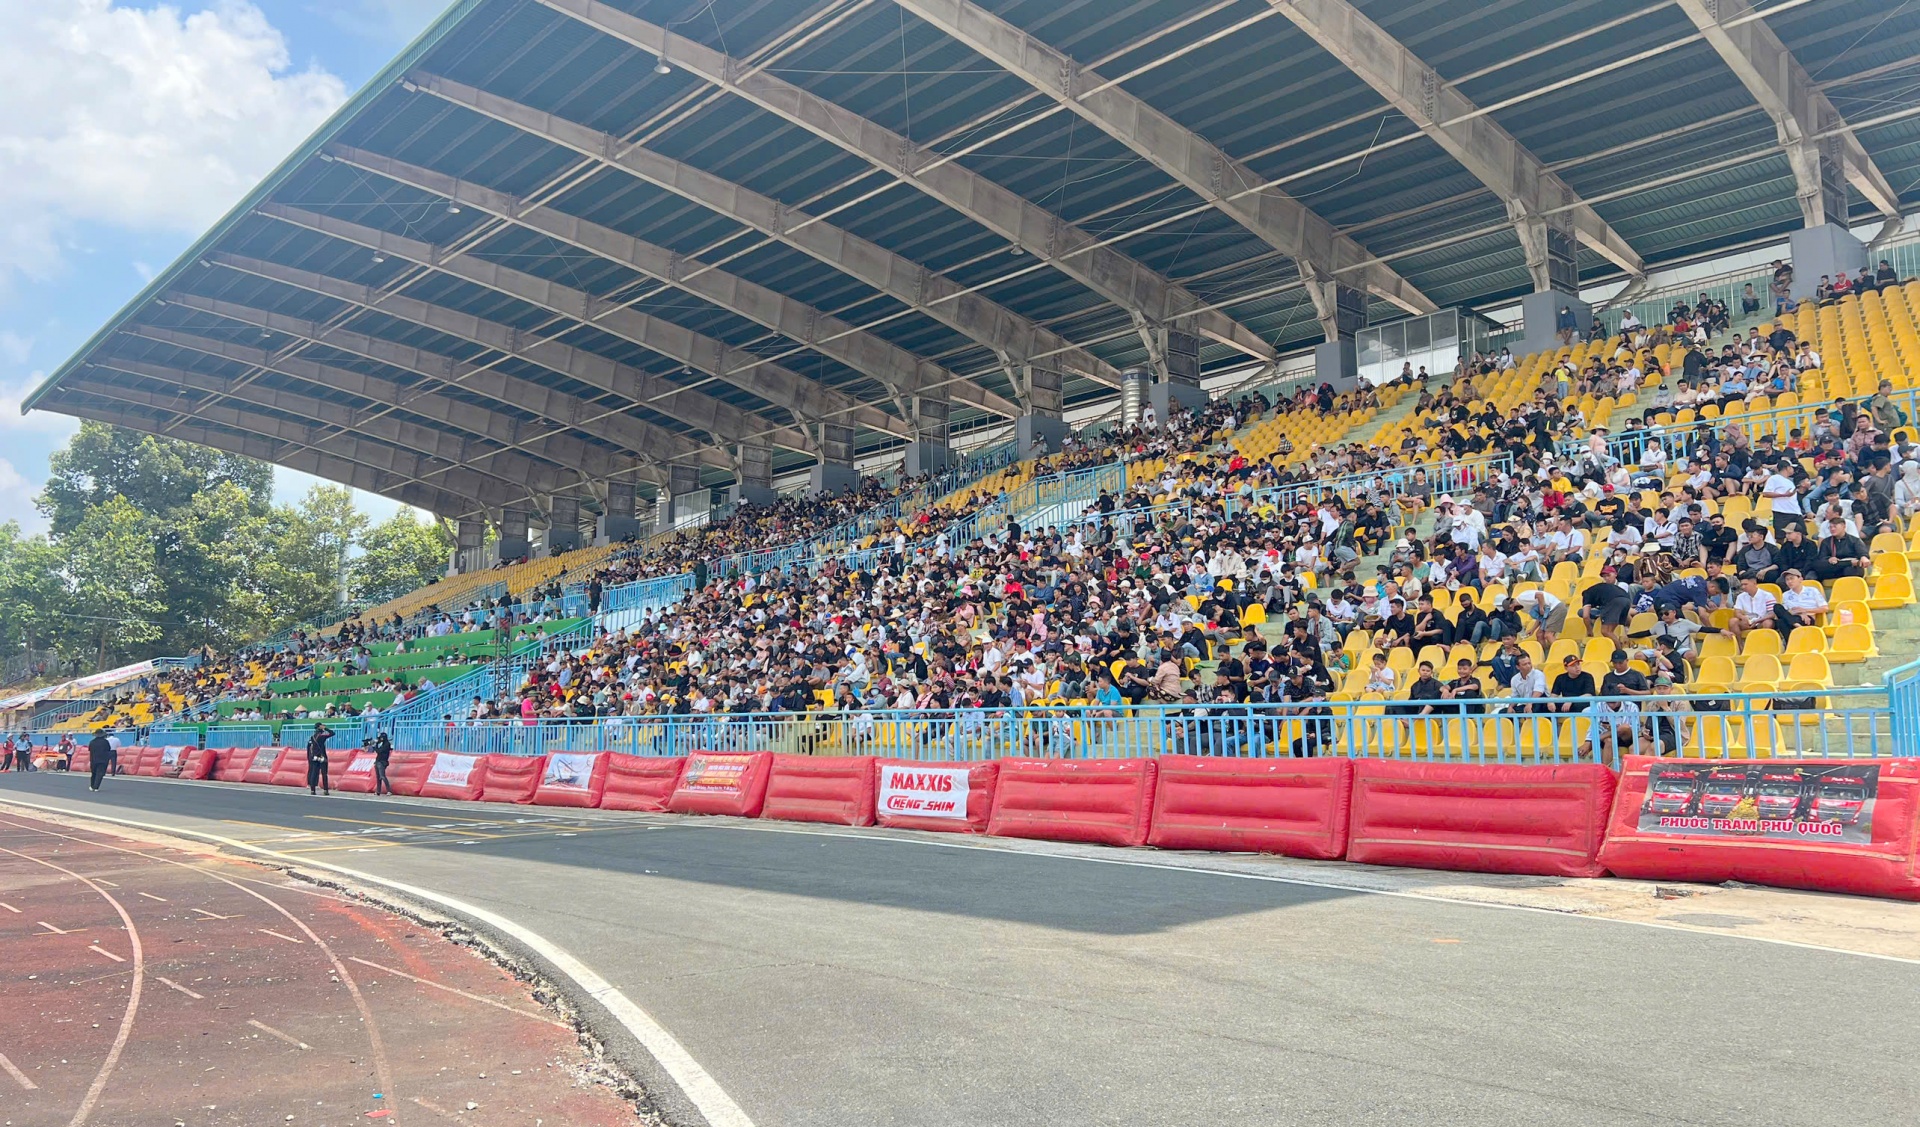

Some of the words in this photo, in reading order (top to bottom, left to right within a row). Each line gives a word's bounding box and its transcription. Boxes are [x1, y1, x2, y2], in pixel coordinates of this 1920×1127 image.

[890, 772, 952, 792] MAXXIS
[887, 795, 924, 810] CHENG
[922, 801, 955, 812] SHIN
[1797, 820, 1842, 835] QUỐC
